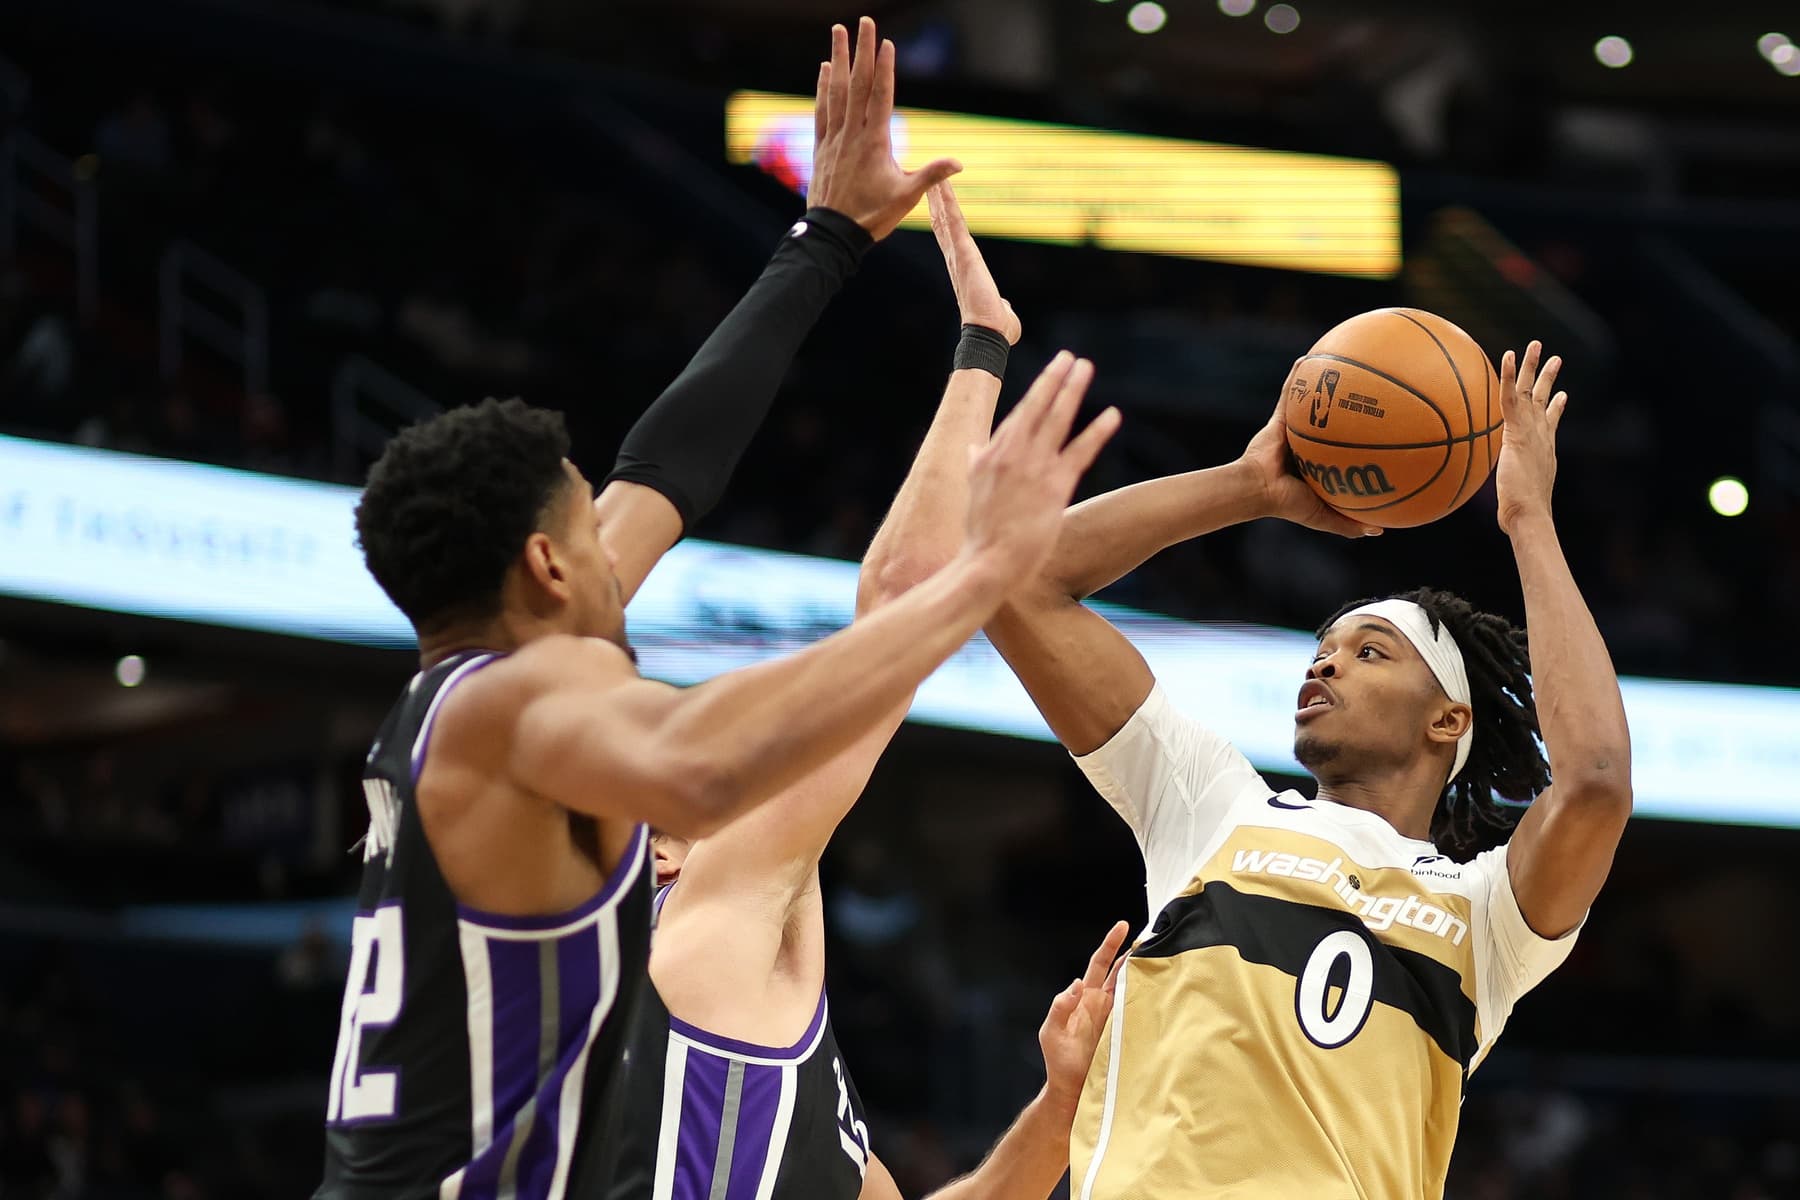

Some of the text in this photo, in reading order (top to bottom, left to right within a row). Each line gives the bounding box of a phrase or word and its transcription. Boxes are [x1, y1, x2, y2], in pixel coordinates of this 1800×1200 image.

[1295, 454, 1395, 496] Wilso
[1231, 849, 1468, 947] washington
[1411, 868, 1461, 880] binhood
[1294, 928, 1374, 1050] 0
